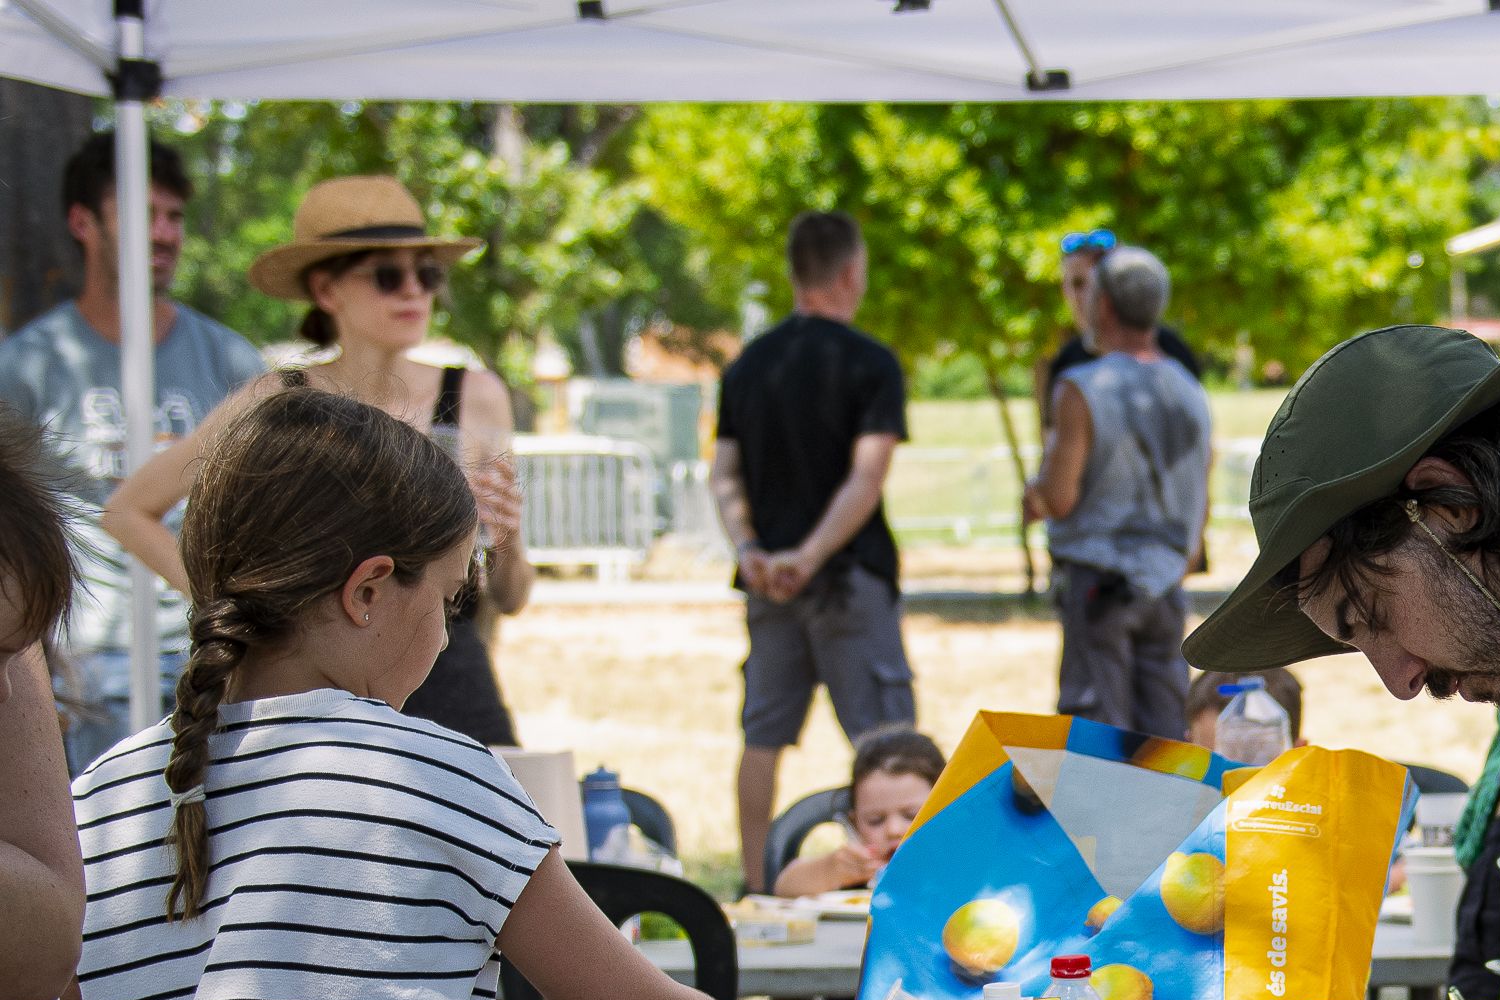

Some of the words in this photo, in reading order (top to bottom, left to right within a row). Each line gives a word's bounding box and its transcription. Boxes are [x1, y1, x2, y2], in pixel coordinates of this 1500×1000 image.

[1268, 869, 1289, 933] savis.
[1267, 937, 1288, 967] de
[1266, 971, 1286, 997] és
